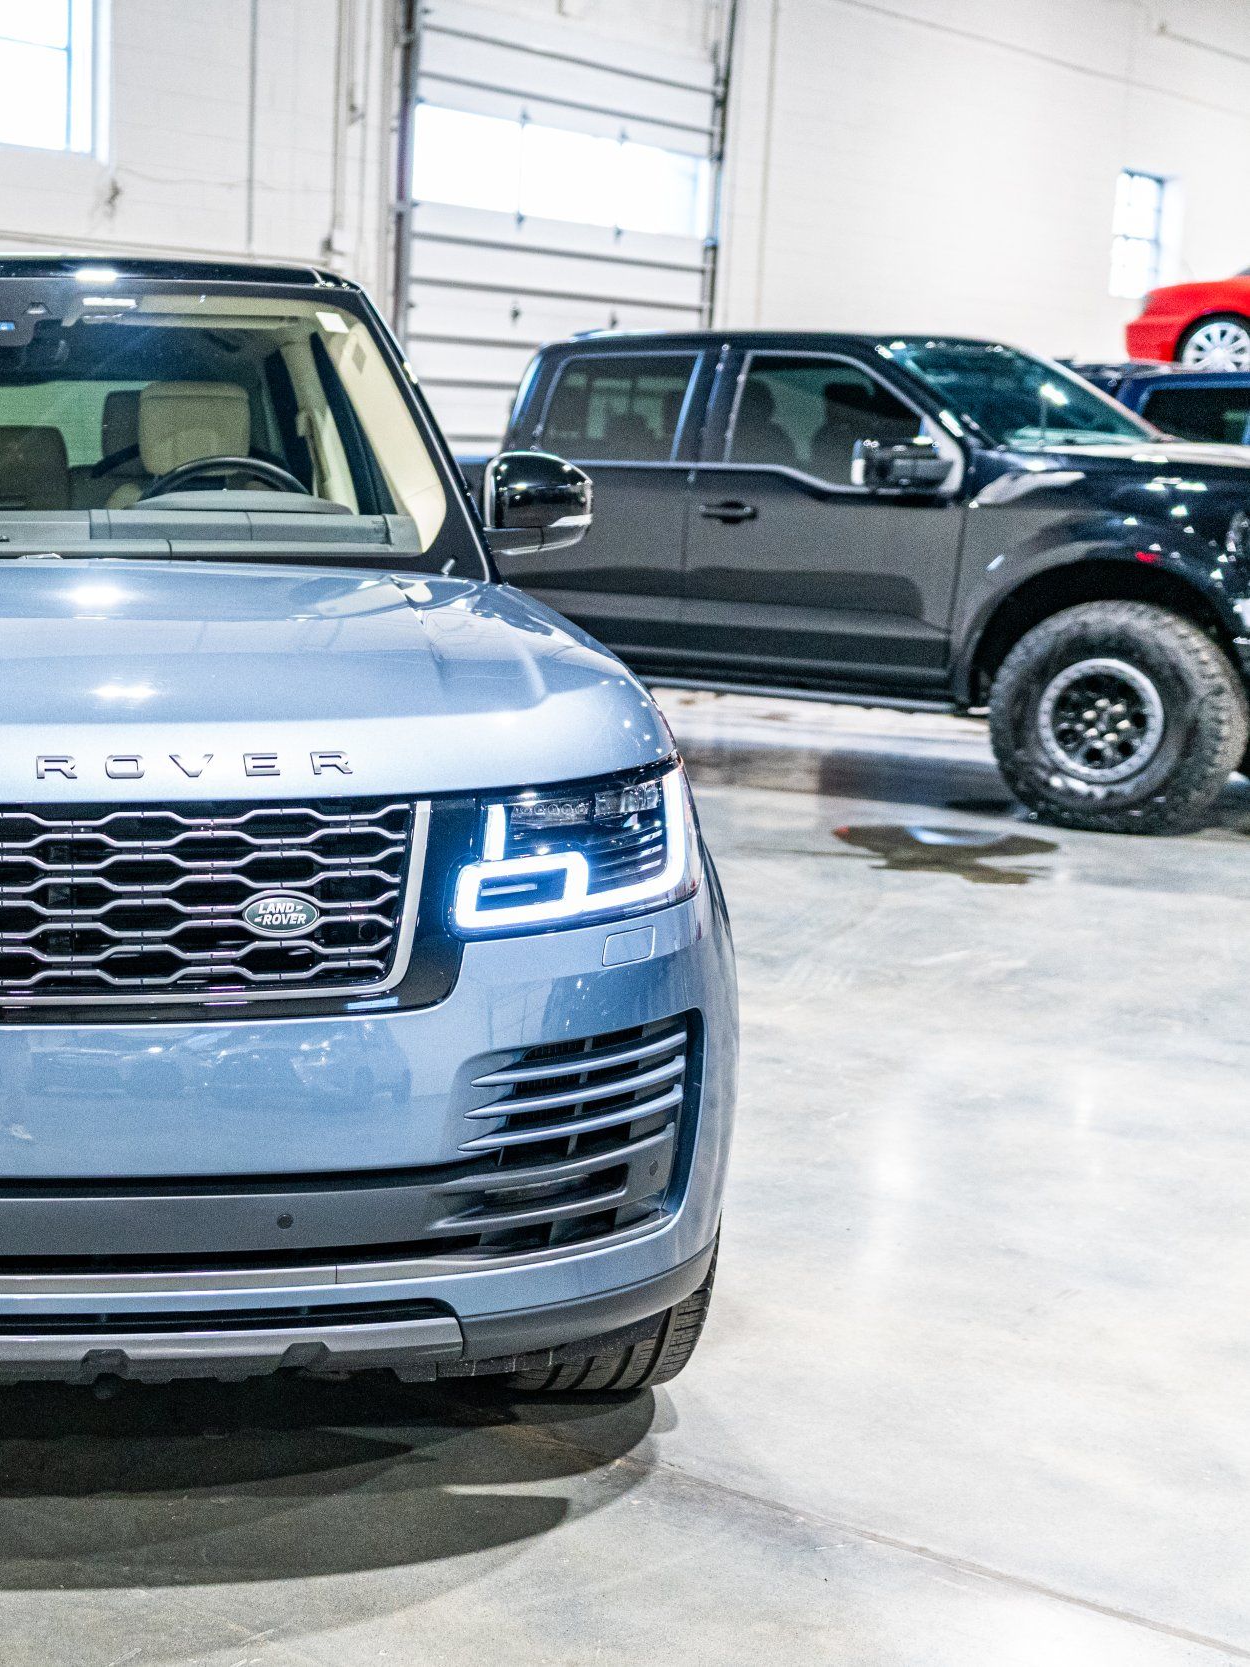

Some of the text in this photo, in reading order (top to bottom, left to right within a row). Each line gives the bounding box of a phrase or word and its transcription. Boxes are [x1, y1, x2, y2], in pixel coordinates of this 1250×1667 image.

[36, 751, 354, 779] ROVER
[258, 902, 295, 914] LAND
[262, 914, 307, 925] ROVER
